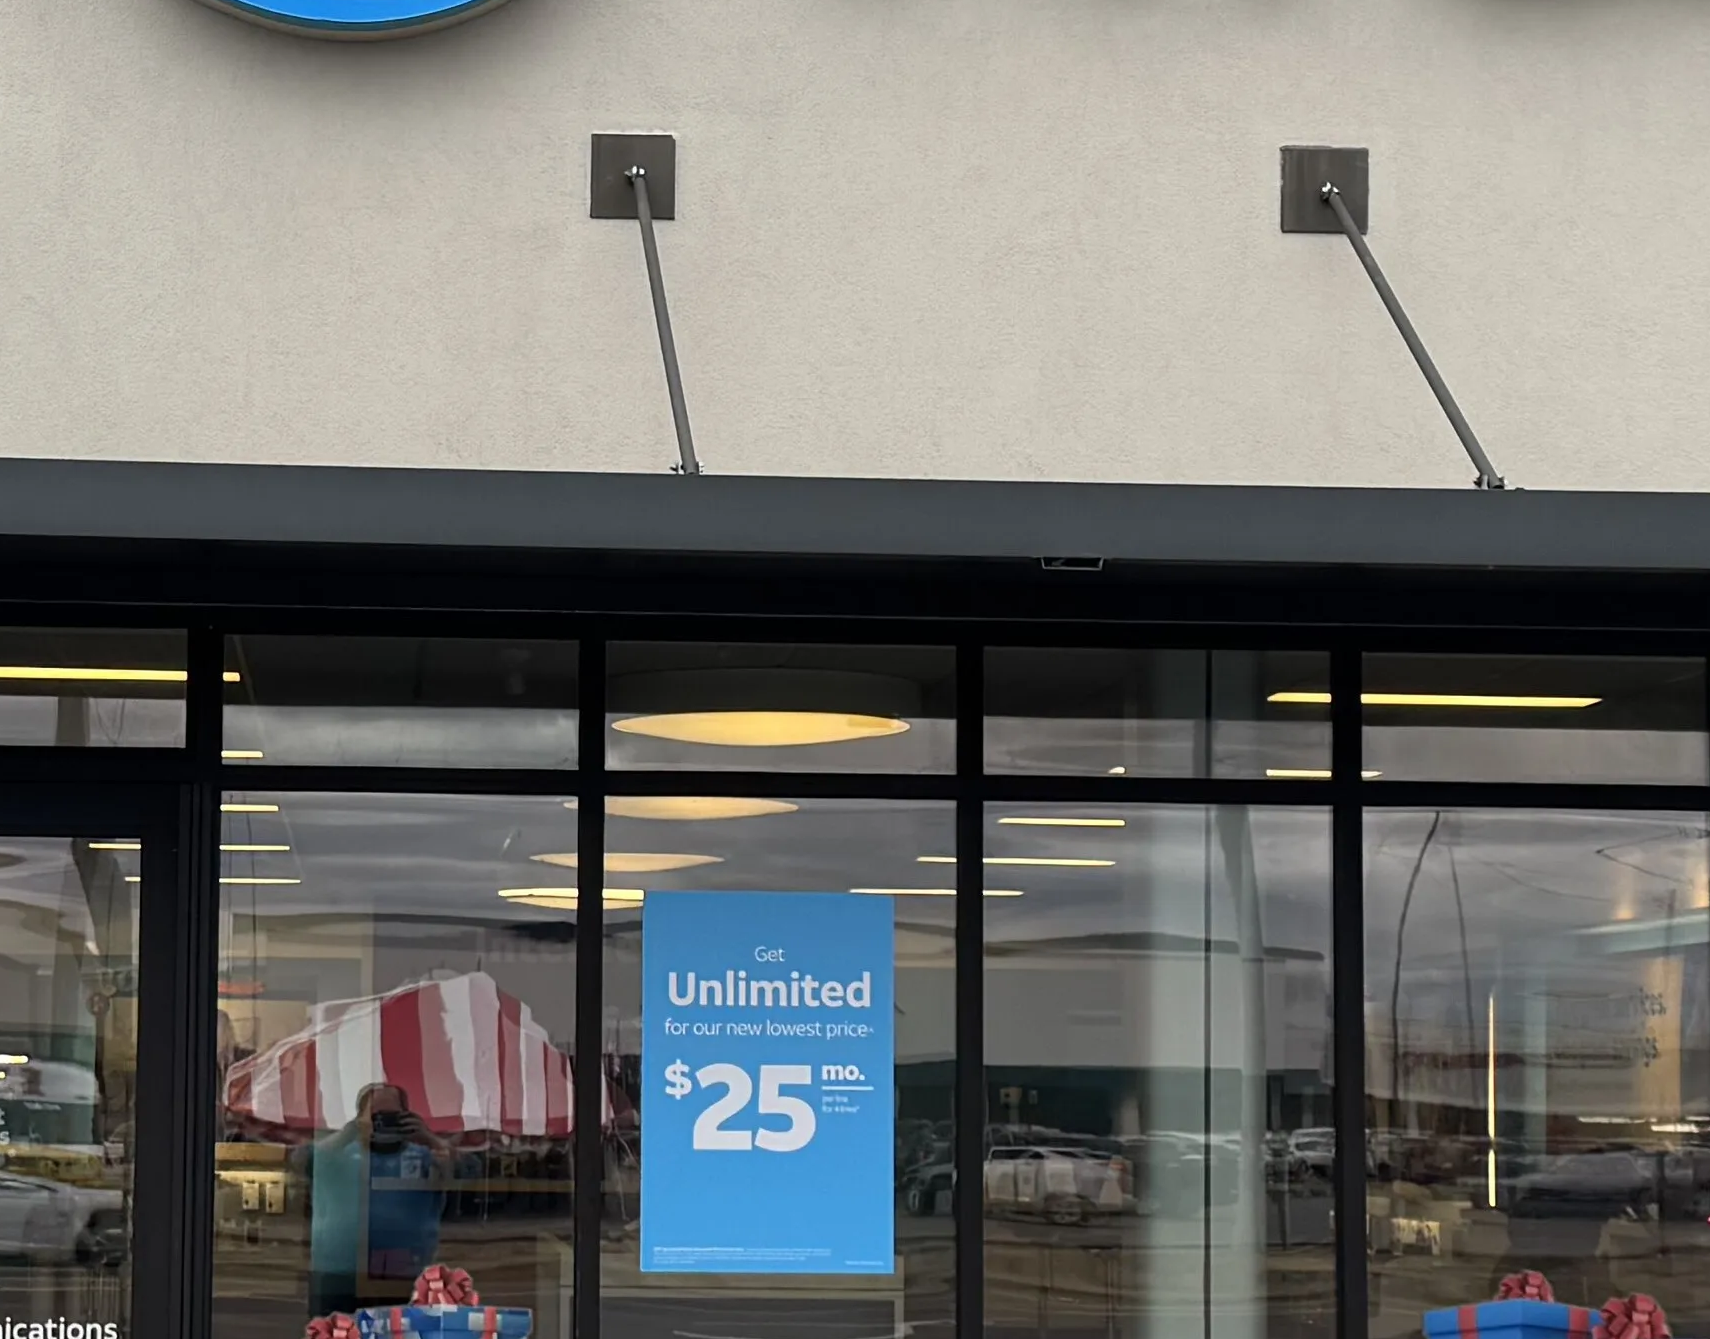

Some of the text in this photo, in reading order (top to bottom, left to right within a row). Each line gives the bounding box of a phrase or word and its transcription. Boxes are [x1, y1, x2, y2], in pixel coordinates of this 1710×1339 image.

[755, 946, 785, 961] Get
[668, 970, 871, 1008] Unlimited
[664, 1018, 689, 1036] for
[693, 1022, 722, 1036] our
[727, 1022, 761, 1036] new
[766, 1019, 822, 1037] lowest
[822, 1065, 866, 1081] mo.
